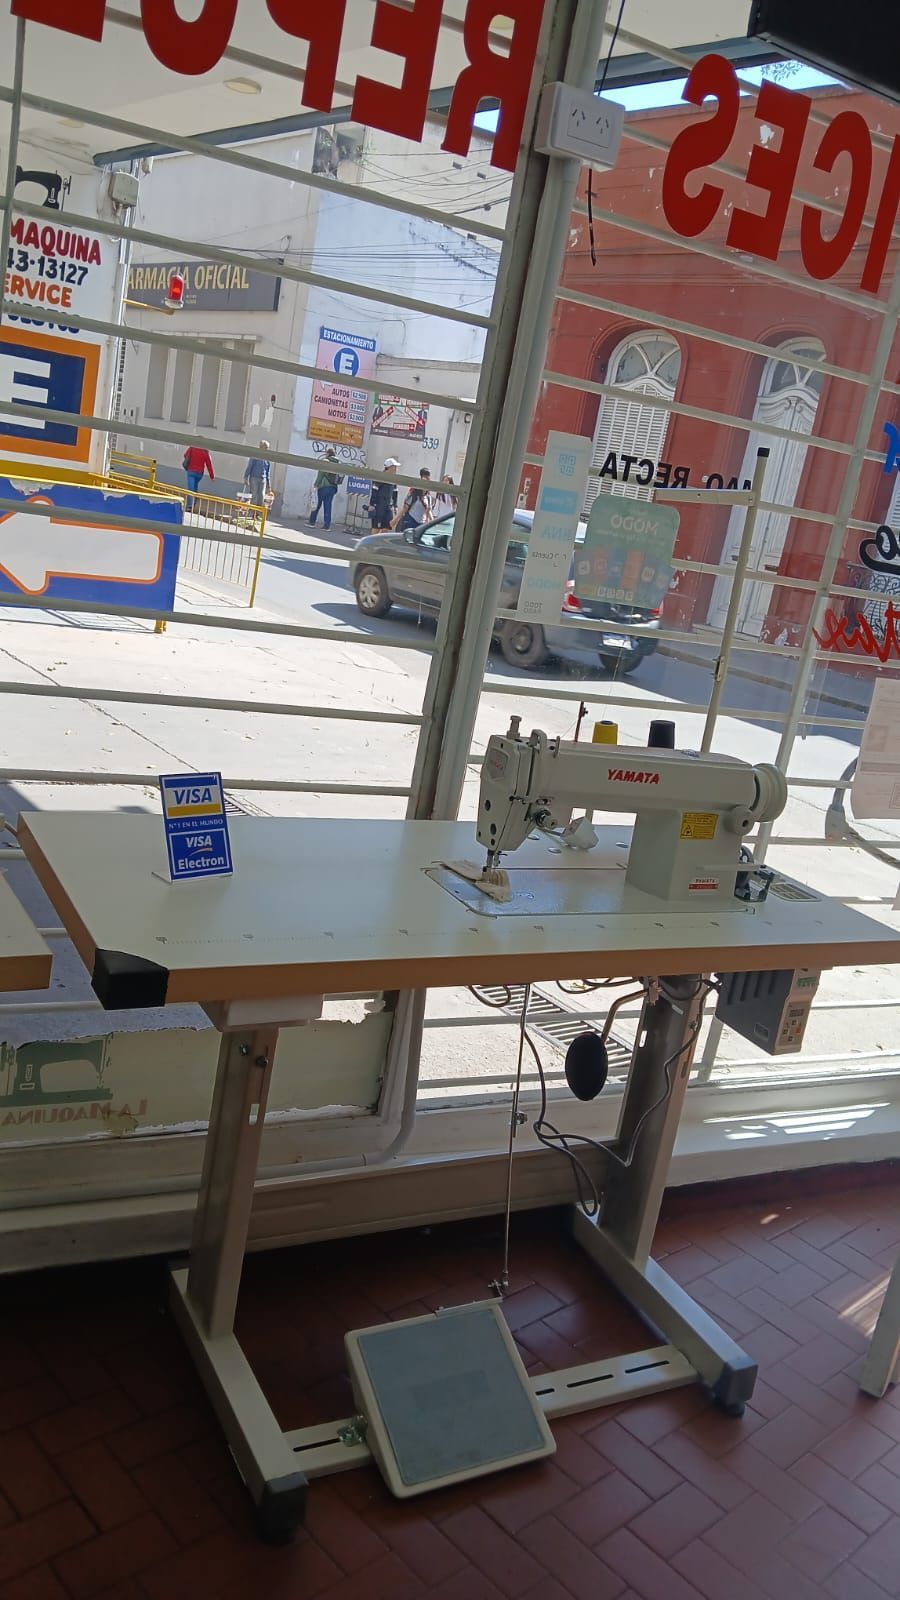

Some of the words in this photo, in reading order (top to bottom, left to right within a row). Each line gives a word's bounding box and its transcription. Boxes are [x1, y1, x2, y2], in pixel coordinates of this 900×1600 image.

[194, 263, 249, 290] OFICIAL
[323, 329, 374, 350] ESTACIONAMIENTO
[339, 352, 355, 376] E
[332, 388, 350, 398] AUTOS
[314, 395, 348, 409] CAMIONETAS
[328, 409, 347, 419] MOTOS
[348, 481, 370, 490] LUGAR
[608, 768, 660, 785] YAMATA
[173, 787, 212, 805] VISA
[200, 818, 224, 826] MUNDO
[186, 835, 212, 848] VISA
[178, 856, 225, 870] Electron
